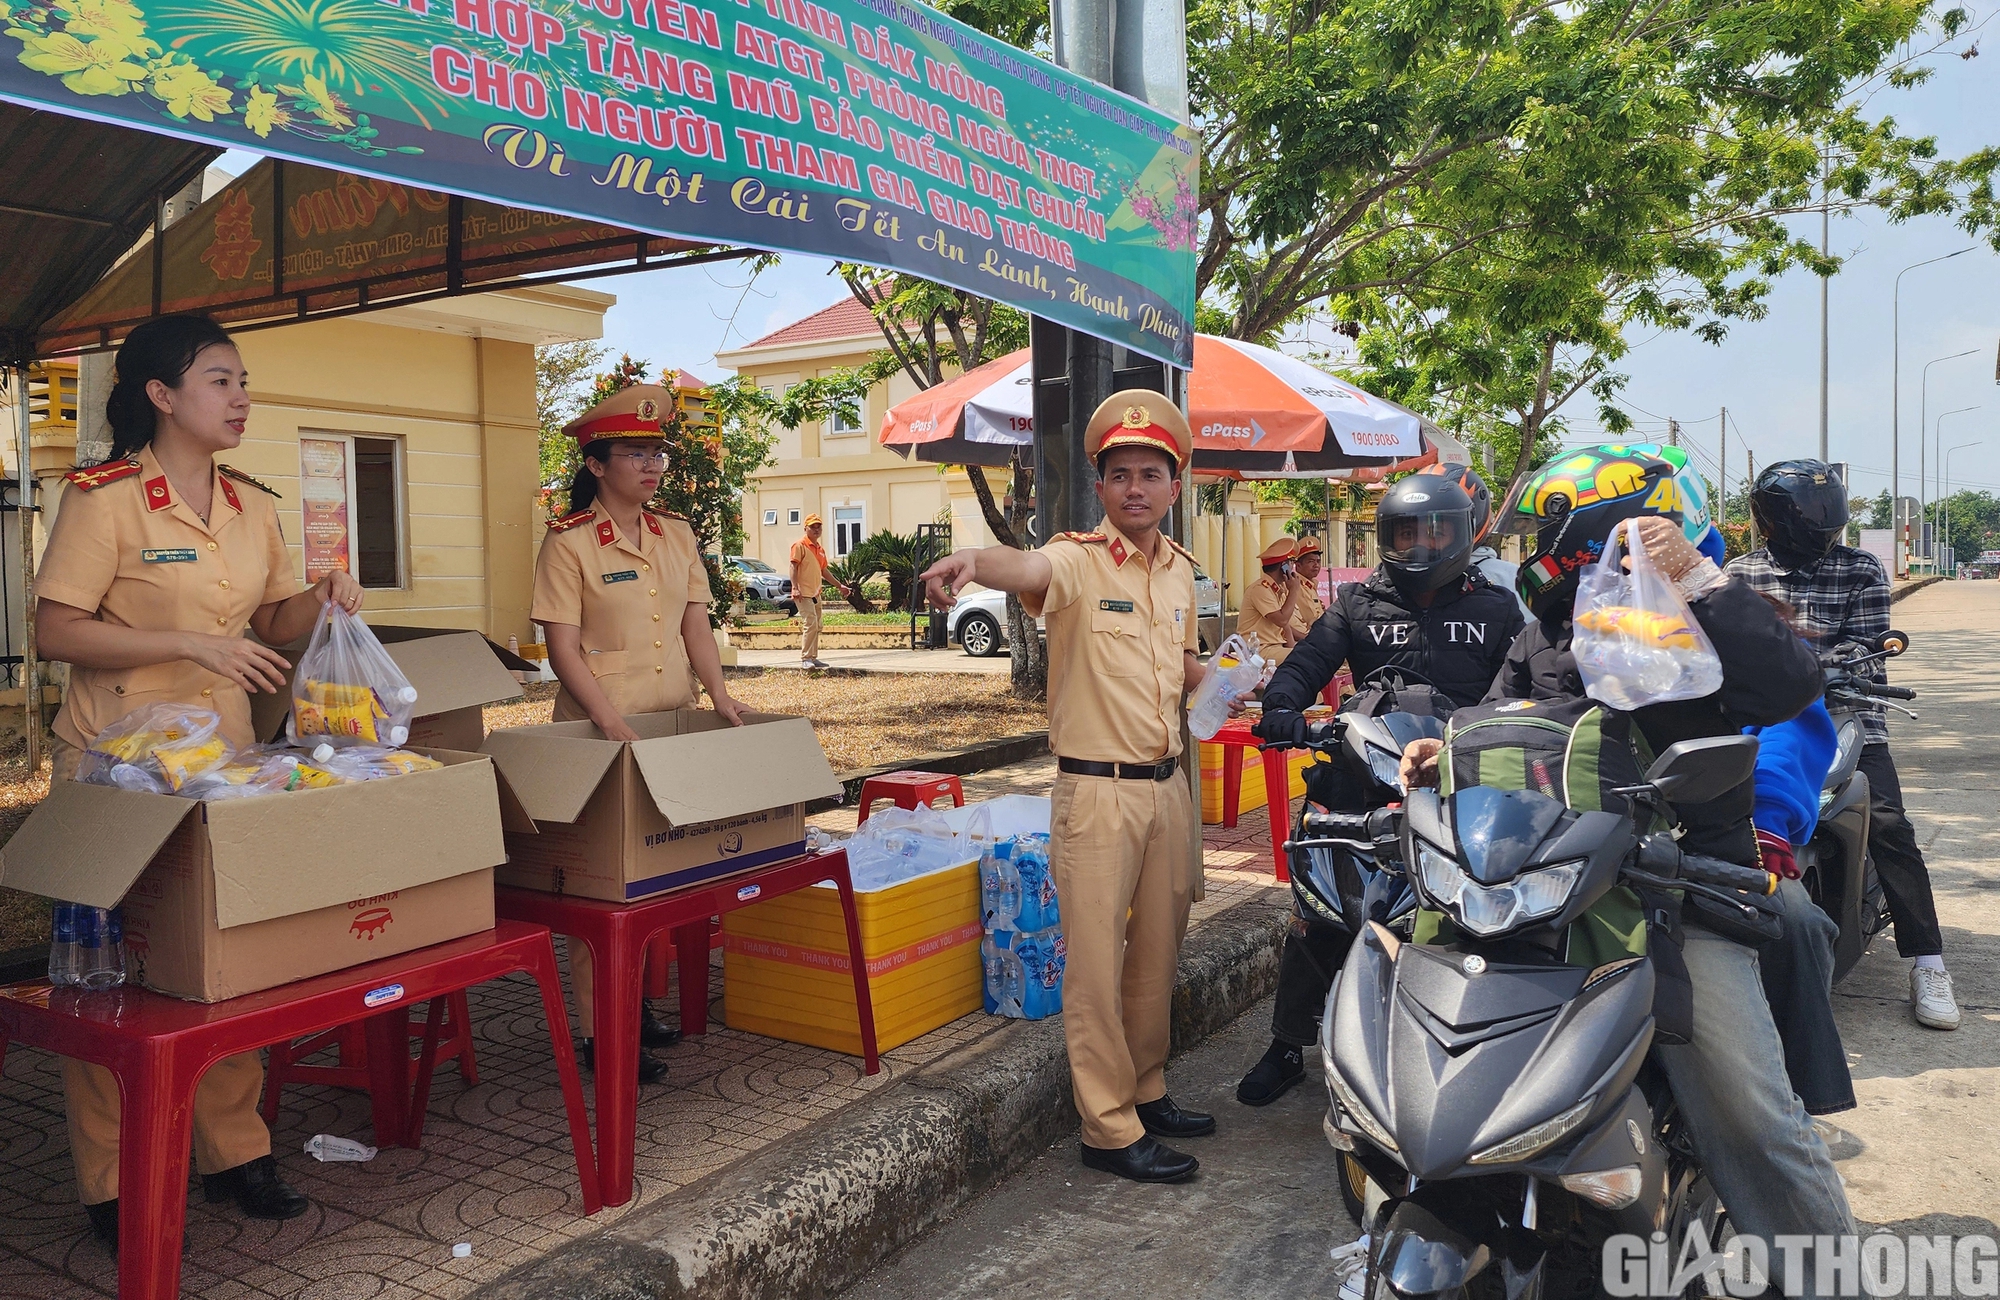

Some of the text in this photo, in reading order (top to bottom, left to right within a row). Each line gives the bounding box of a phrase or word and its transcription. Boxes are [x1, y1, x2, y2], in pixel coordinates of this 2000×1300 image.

[900, 4, 928, 36] CÙNG
[959, 33, 985, 62] THAM
[986, 46, 1003, 71] GIA
[1003, 54, 1024, 80] GIAO
[1024, 64, 1052, 93] THÔNG
[1054, 78, 1068, 103] DỊP
[1069, 82, 1083, 107] TẾT
[851, 22, 921, 82] ĐẮK
[924, 56, 1006, 121] NÔNG
[734, 21, 840, 93] ATGT,
[843, 62, 953, 141] PHÒNG
[956, 114, 1032, 175] NGỪA
[1035, 149, 1101, 199] TNGT.
[453, 0, 1107, 243] HỢP TẶNG MŨ BẢO HIỂM ĐẠT CHUẨN
[430, 44, 1076, 272] CHO NGƯỜI THAM GIA GIAO THÔNG
[483, 122, 1182, 343] Vì Một Cái Tết An Lành, Hạnh Phúc
[909, 419, 933, 433] ePass
[1201, 423, 1251, 439] ePass
[1351, 431, 1400, 446] 1900 9080
[1538, 574, 1565, 594] ASIA
[1367, 621, 1488, 646] VE TN
[645, 835, 654, 849] VỊ
[655, 831, 668, 844] BƠ
[668, 828, 685, 842] NHO
[743, 941, 771, 955] THANK
[771, 945, 788, 957] YOU
[916, 935, 953, 956] THANK YOU
[801, 951, 849, 969] THANK YOU
[866, 952, 907, 973] THANK YOU
